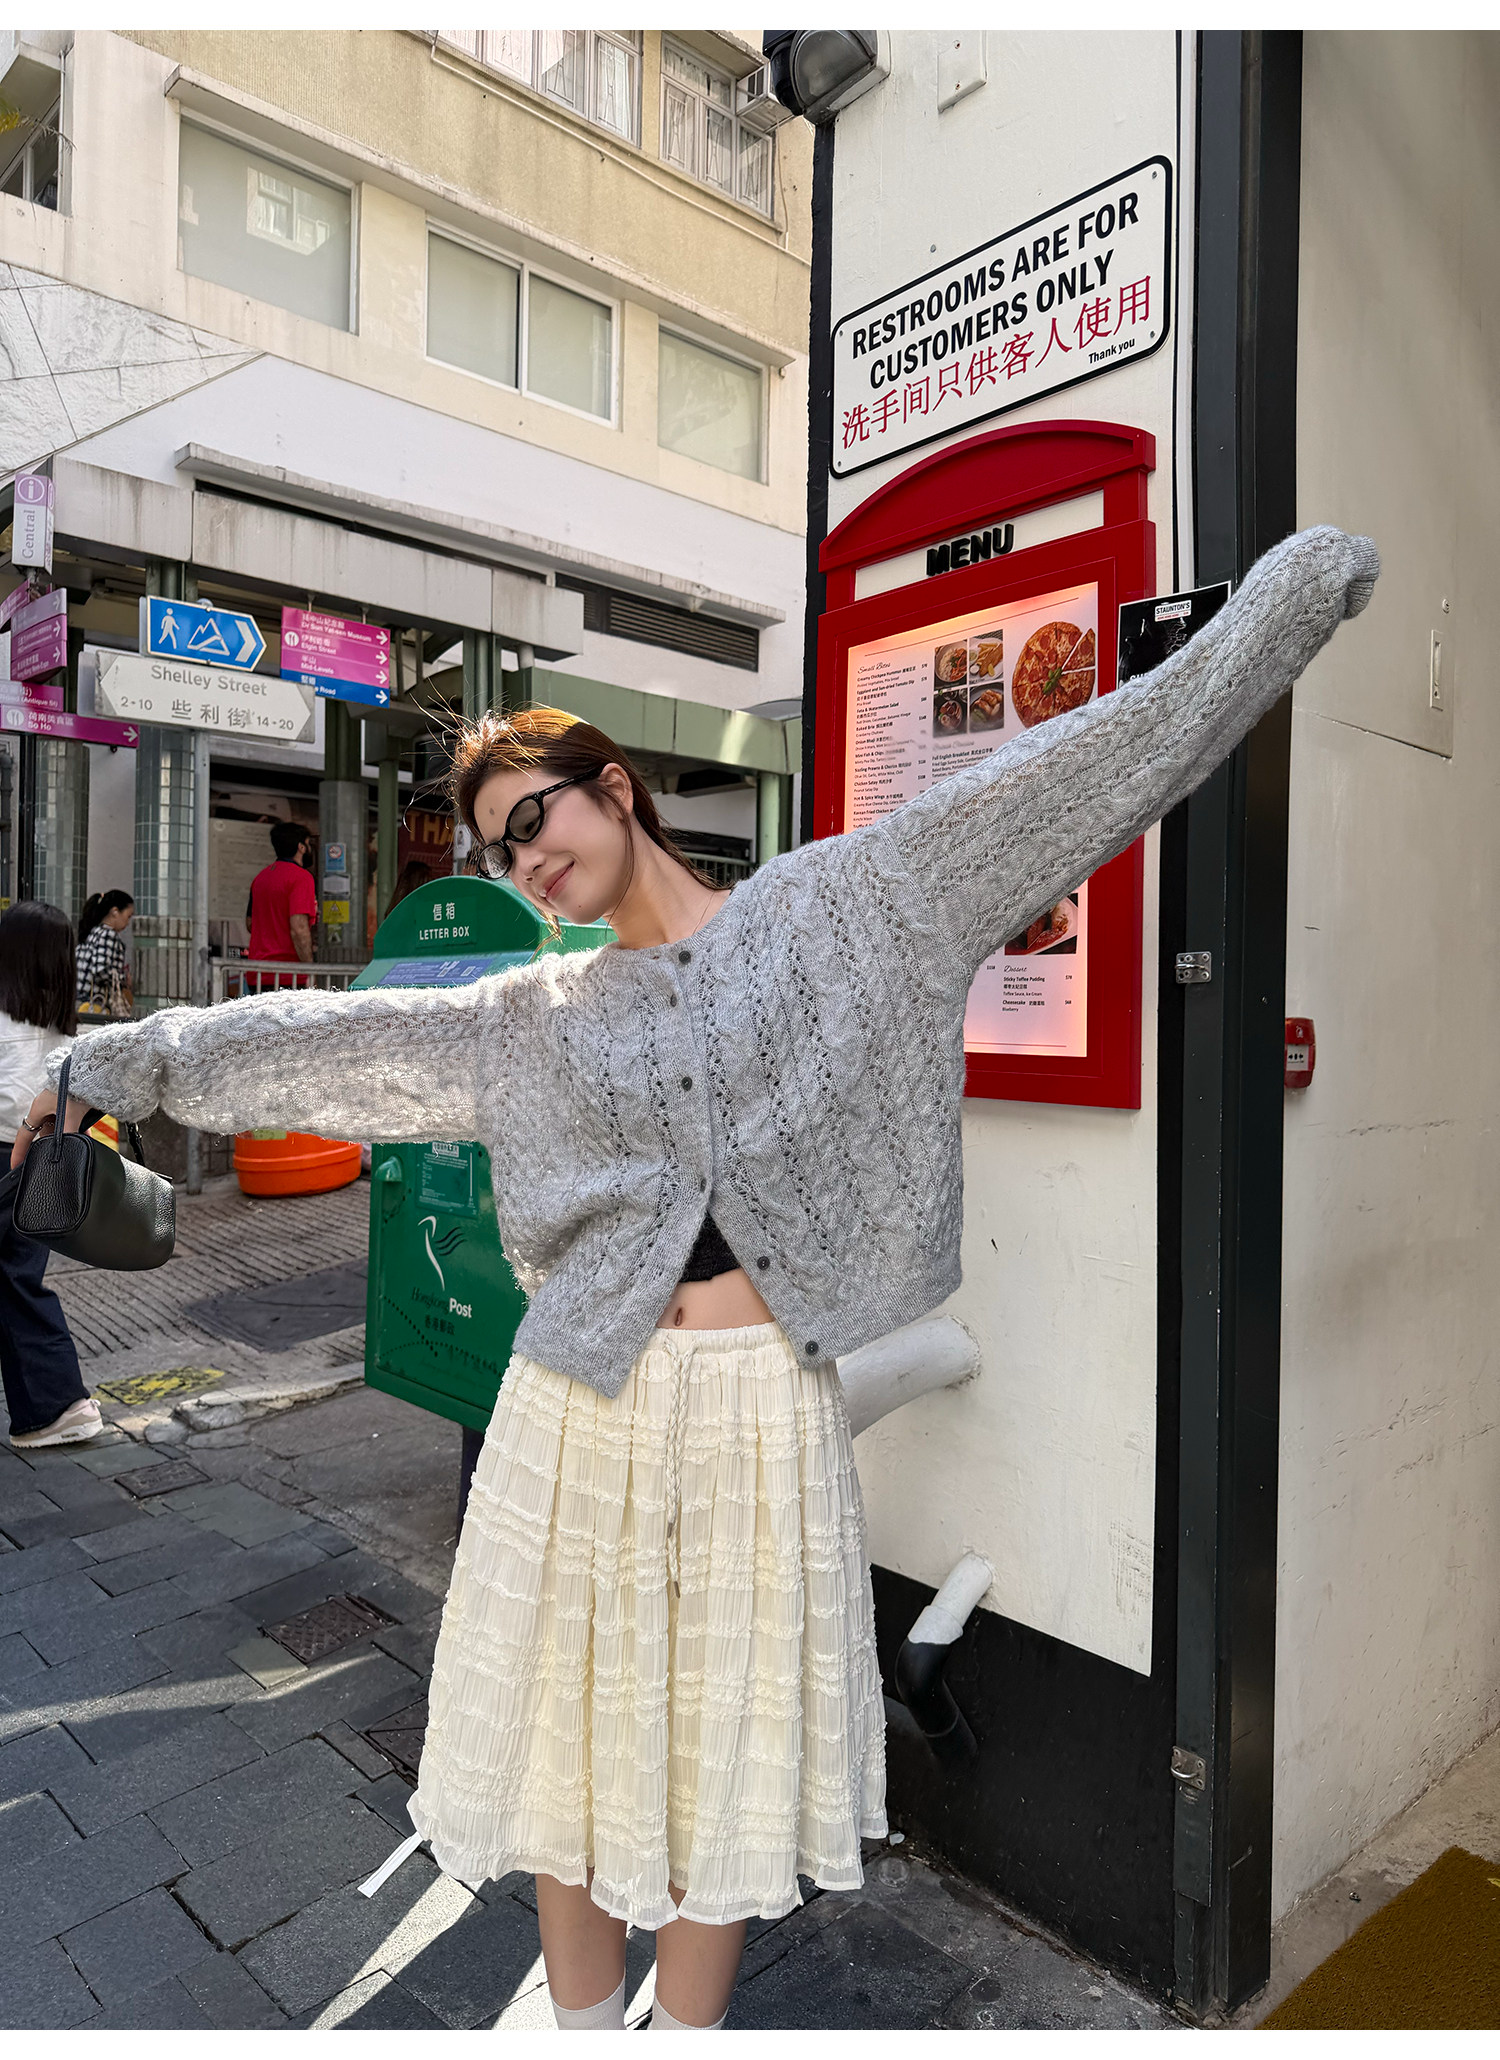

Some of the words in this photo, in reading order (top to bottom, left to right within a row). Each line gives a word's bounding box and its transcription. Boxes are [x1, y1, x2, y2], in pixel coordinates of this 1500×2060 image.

[852, 258, 1005, 359] RESTROOMS
[1011, 225, 1069, 283] ARE
[1078, 191, 1139, 249] FOR
[870, 291, 1028, 389] CUSTOMERS
[1036, 248, 1115, 313] ONLY
[1088, 344, 1117, 365] Thank
[1118, 337, 1135, 356] you
[841, 275, 1151, 450] 洗手间只供客人使用
[22, 509, 35, 559] Central
[926, 523, 1014, 577] MENU
[1156, 602, 1190, 614] STAUNTON'S
[301, 621, 310, 629] Dr
[310, 623, 323, 632] Sun
[347, 631, 372, 642] Museum
[301, 643, 318, 651] Elgin
[319, 646, 336, 655] Street
[301, 663, 334, 675] Mid-Levels
[858, 665, 875, 674] Small
[151, 664, 211, 690] Shelley
[218, 676, 267, 696] Street
[320, 686, 336, 696] Road
[433, 902, 455, 921] 信箱
[419, 928, 449, 941] LETTER
[452, 926, 470, 937] BOX
[449, 1297, 472, 1318] Post
